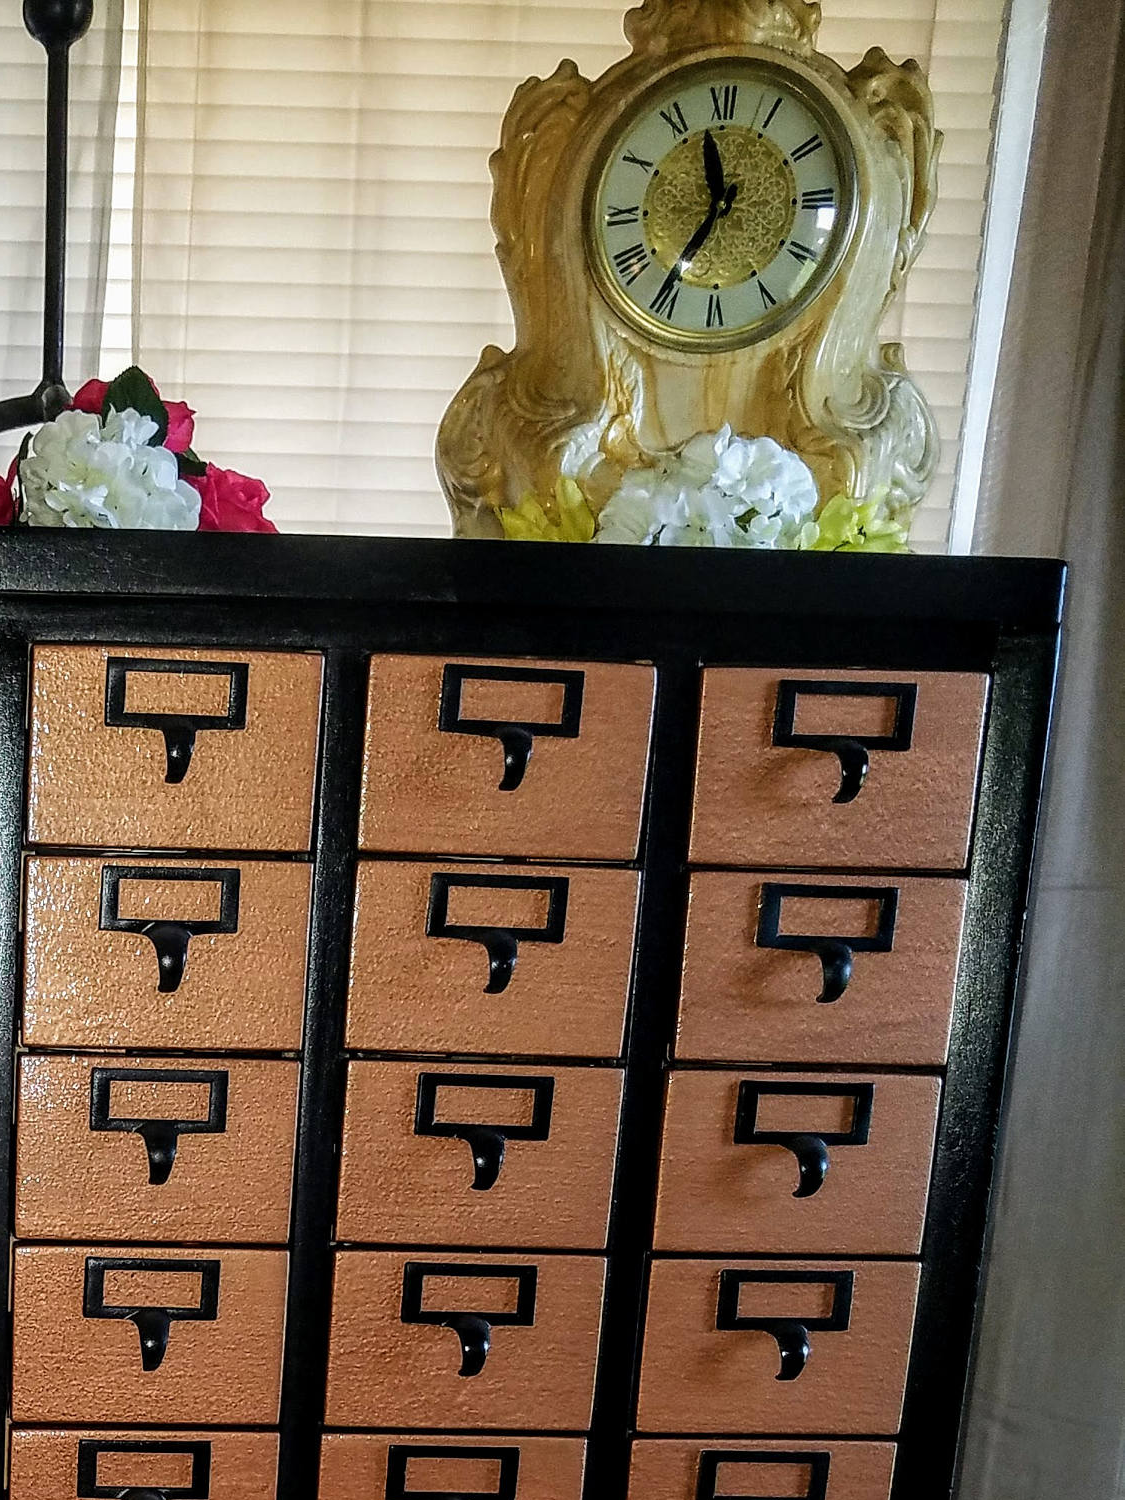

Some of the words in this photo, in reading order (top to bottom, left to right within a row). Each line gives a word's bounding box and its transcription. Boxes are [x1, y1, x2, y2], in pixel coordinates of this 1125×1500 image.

[709, 86, 738, 121] XII
[659, 101, 688, 138] XI
[622, 149, 653, 173] X
[790, 134, 823, 163] II
[801, 188, 834, 209] III
[757, 279, 776, 309] V
[706, 294, 723, 328] VI
